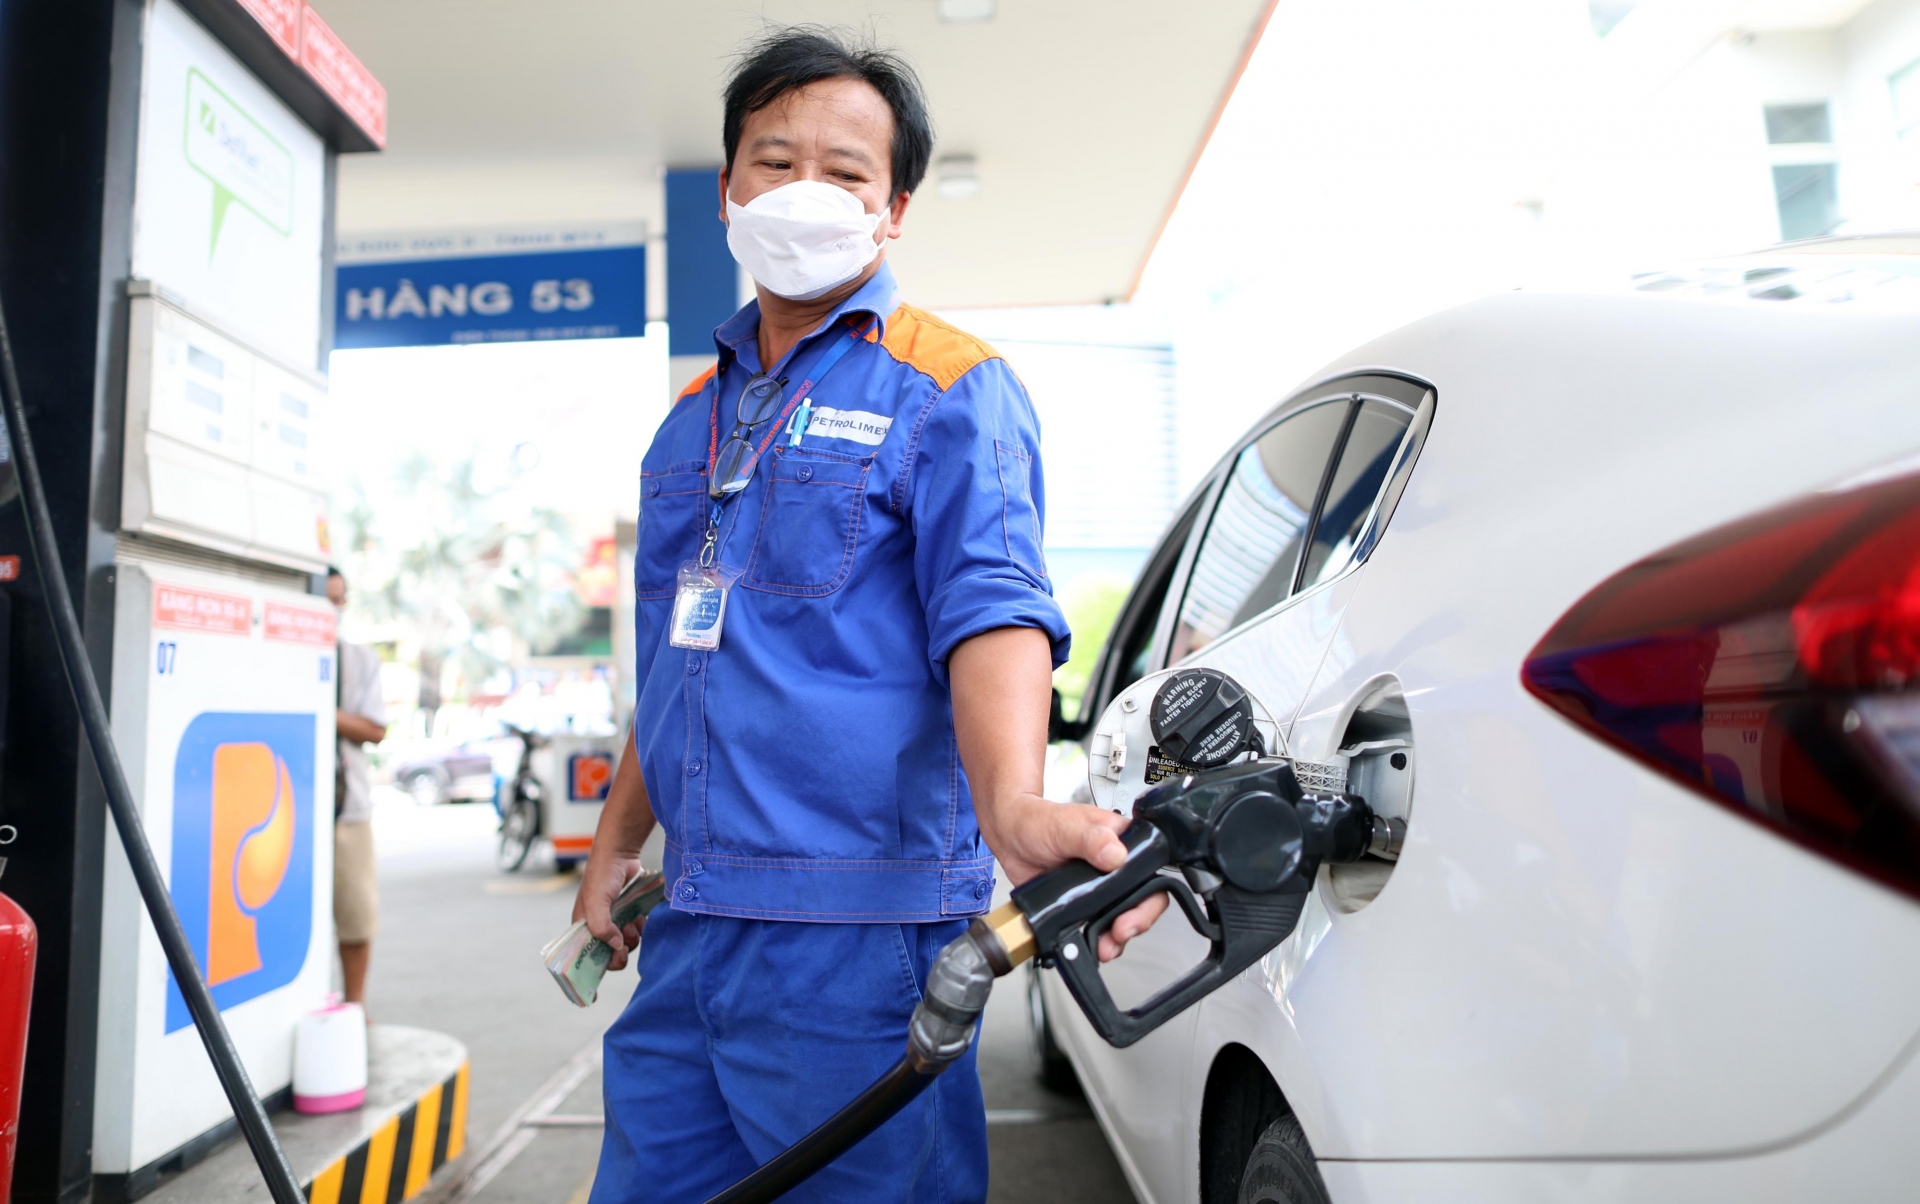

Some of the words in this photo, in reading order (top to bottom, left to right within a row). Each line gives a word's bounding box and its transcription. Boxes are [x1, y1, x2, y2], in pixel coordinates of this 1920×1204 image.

[345, 278, 514, 321] HÀNG
[529, 277, 595, 313] 53
[812, 416, 887, 436] PETROLIMEX
[157, 641, 176, 675] 07
[1162, 678, 1195, 706] WARNING
[1165, 694, 1188, 714] REMOVE
[1186, 677, 1208, 697] SLOWLY
[1160, 709, 1181, 727] FASTEN
[1181, 689, 1204, 712] TIGHTLY
[1206, 723, 1237, 750] RIMUOVERE
[1214, 711, 1242, 735] CHIUDERE
[1191, 746, 1209, 762] PIANO
[1199, 733, 1215, 747] BENE
[1205, 729, 1241, 761] ATTENZIONE
